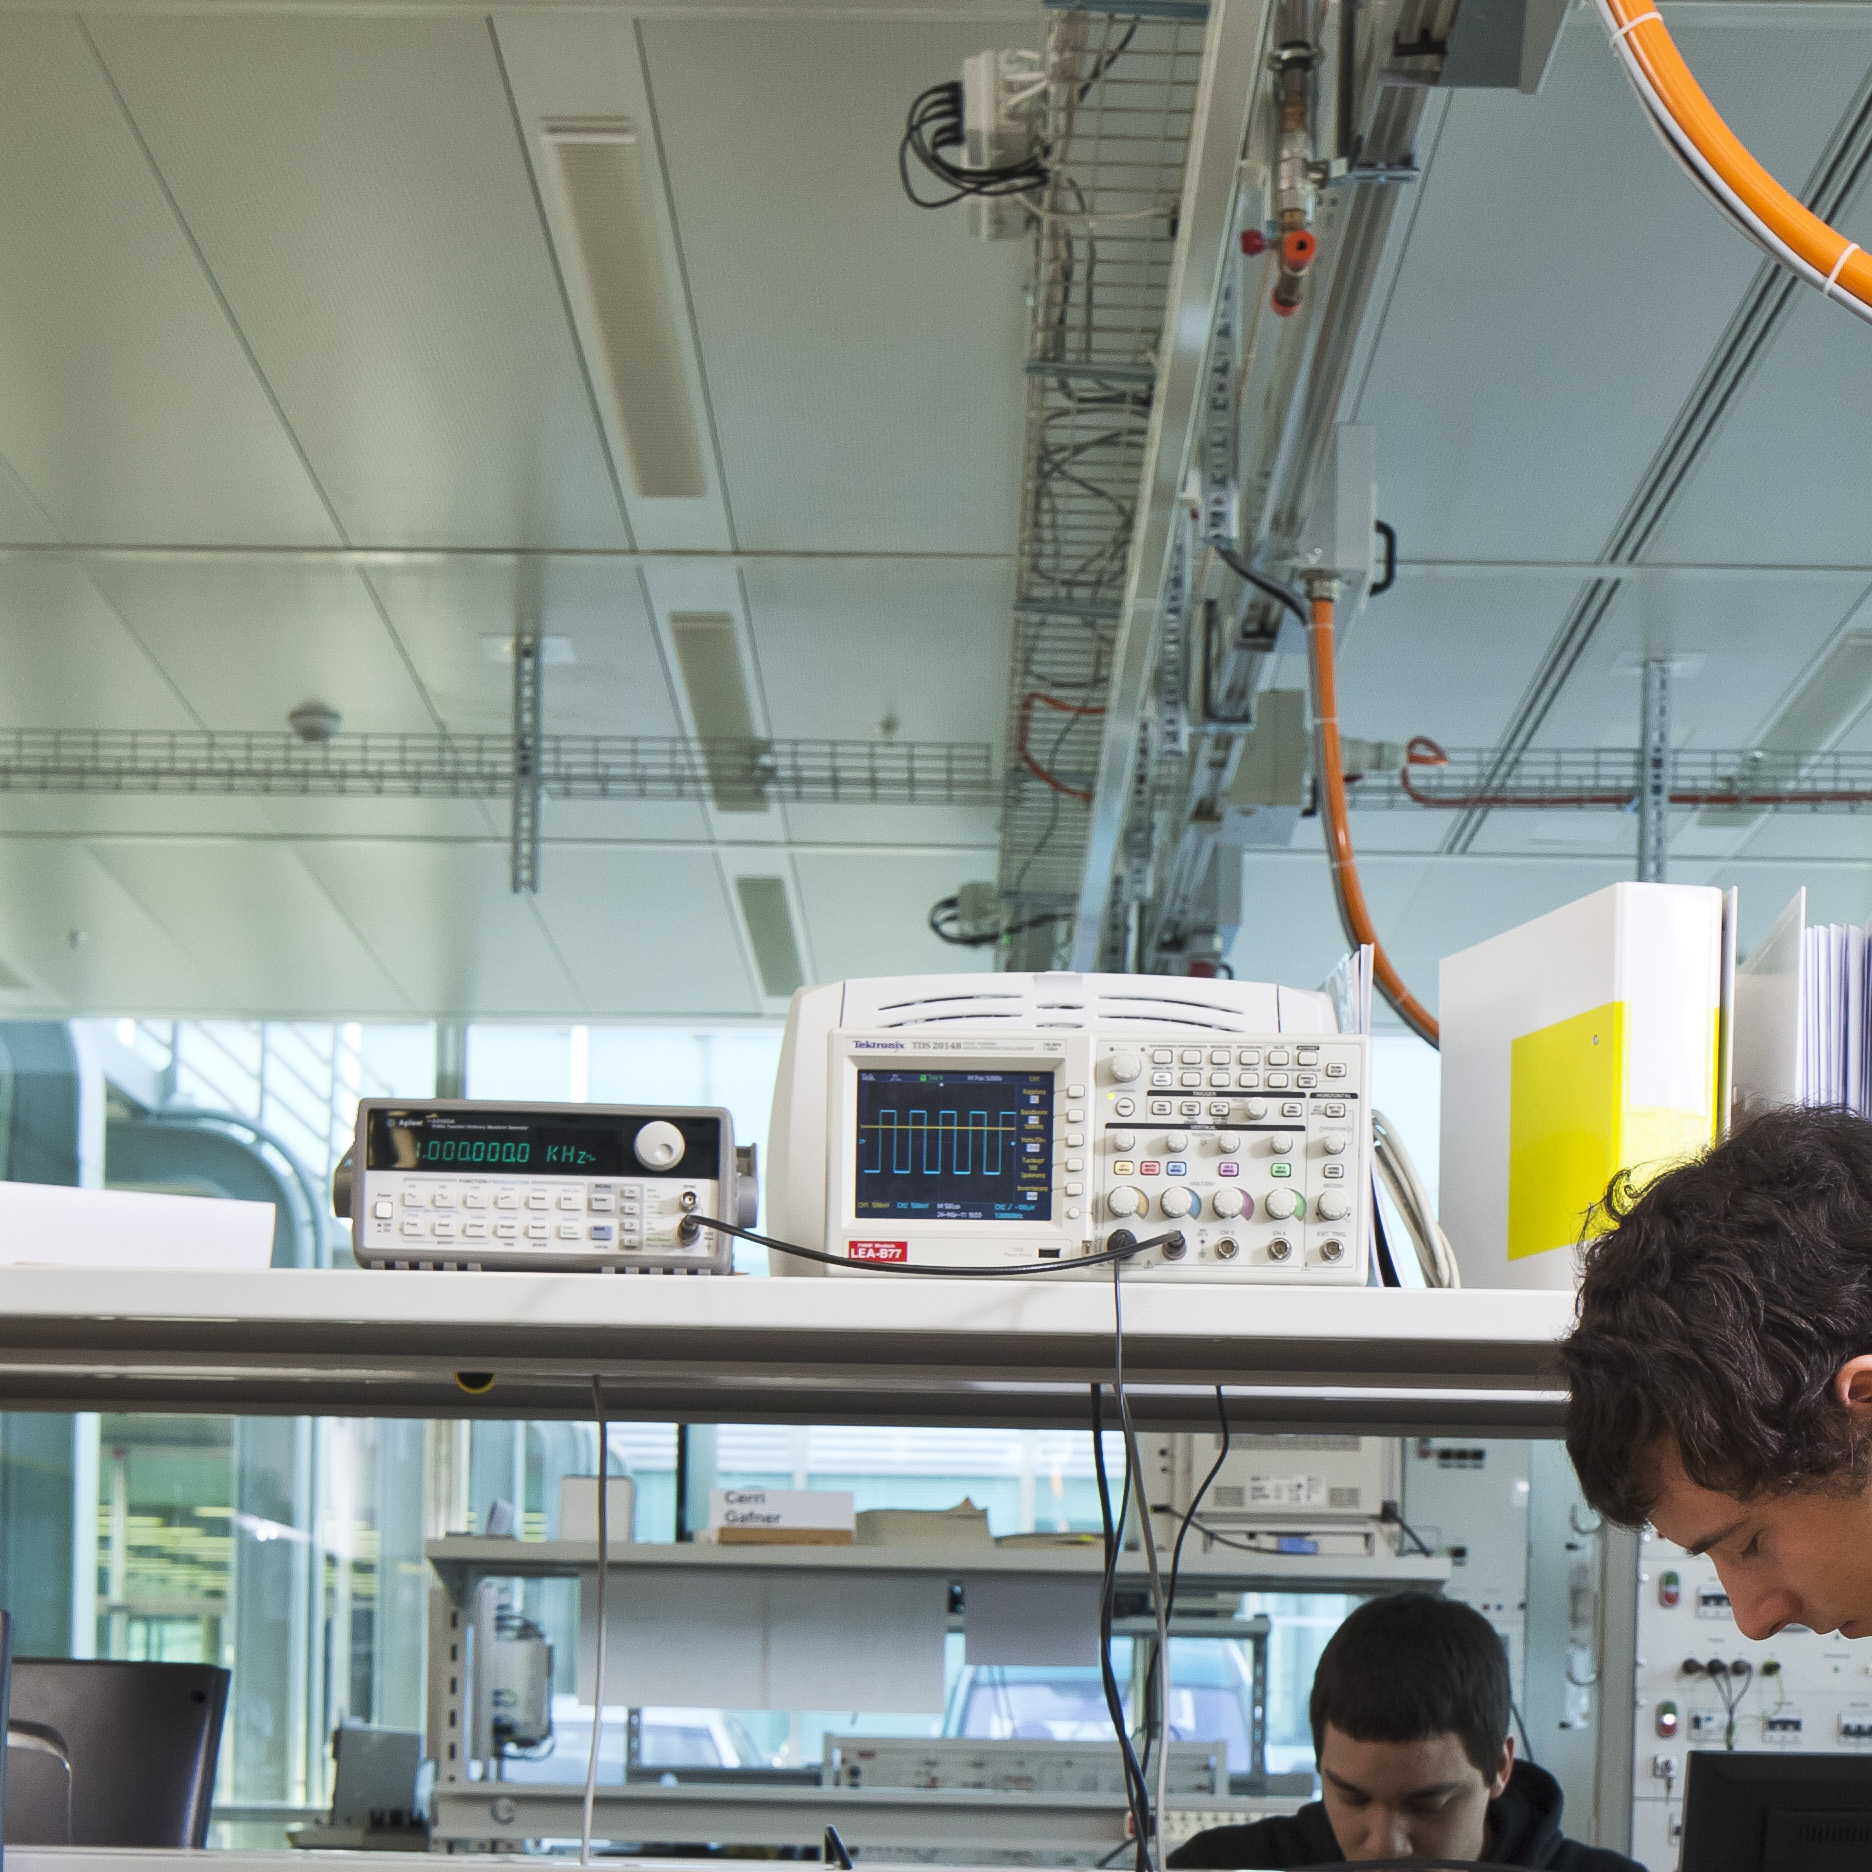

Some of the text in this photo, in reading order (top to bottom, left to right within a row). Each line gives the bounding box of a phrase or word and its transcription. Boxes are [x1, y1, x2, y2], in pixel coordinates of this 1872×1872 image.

[853, 1040, 906, 1050] Tektronix
[911, 1041, 931, 1050] TDS
[850, 1248, 902, 1259] LEA-B77
